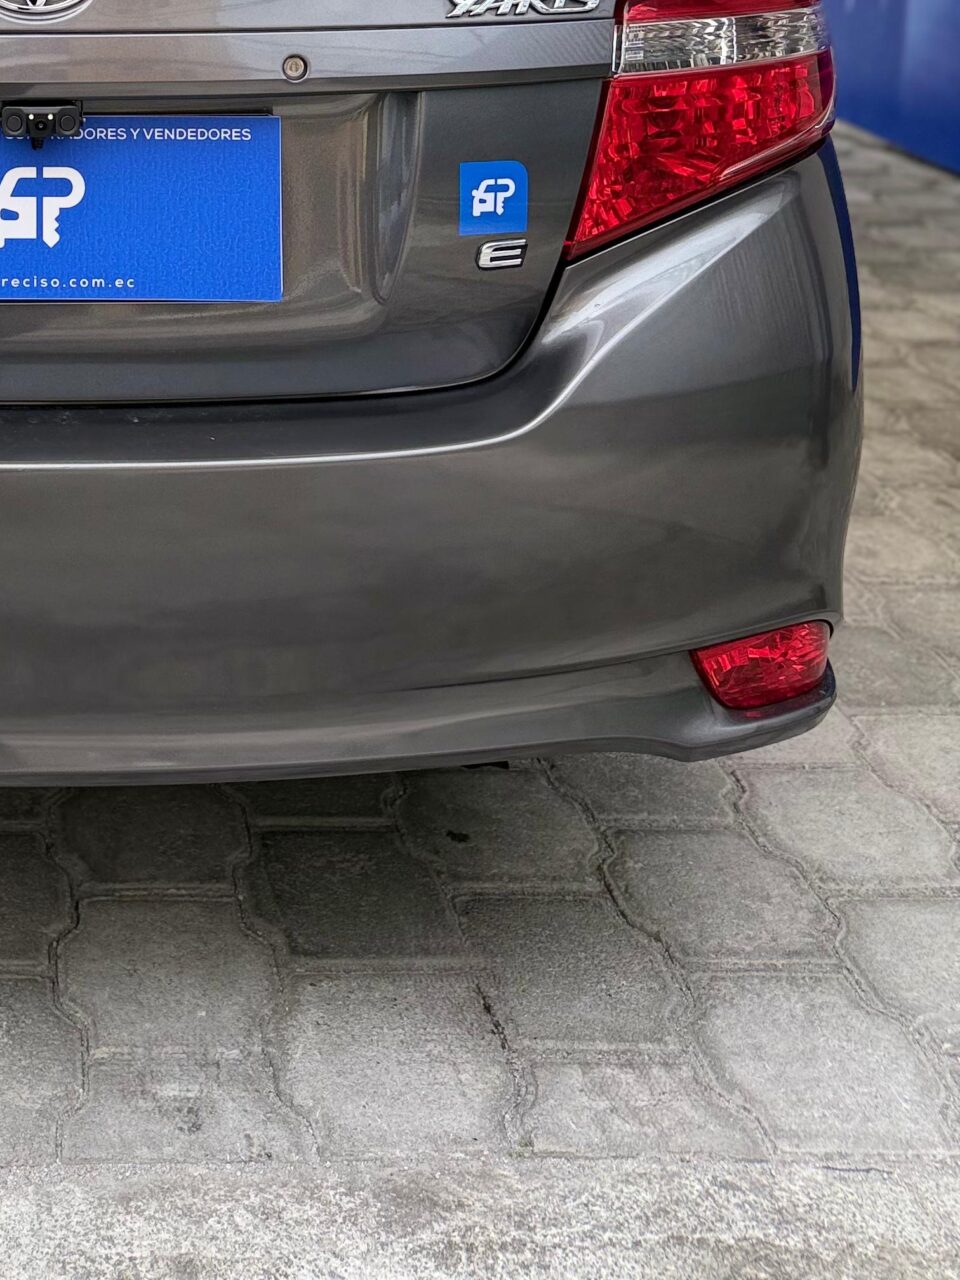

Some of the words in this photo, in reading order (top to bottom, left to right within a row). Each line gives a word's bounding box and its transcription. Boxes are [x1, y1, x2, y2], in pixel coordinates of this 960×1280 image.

[130, 128, 141, 140] Y
[143, 128, 252, 141] VENDEDORES
[476, 238, 528, 270] E
